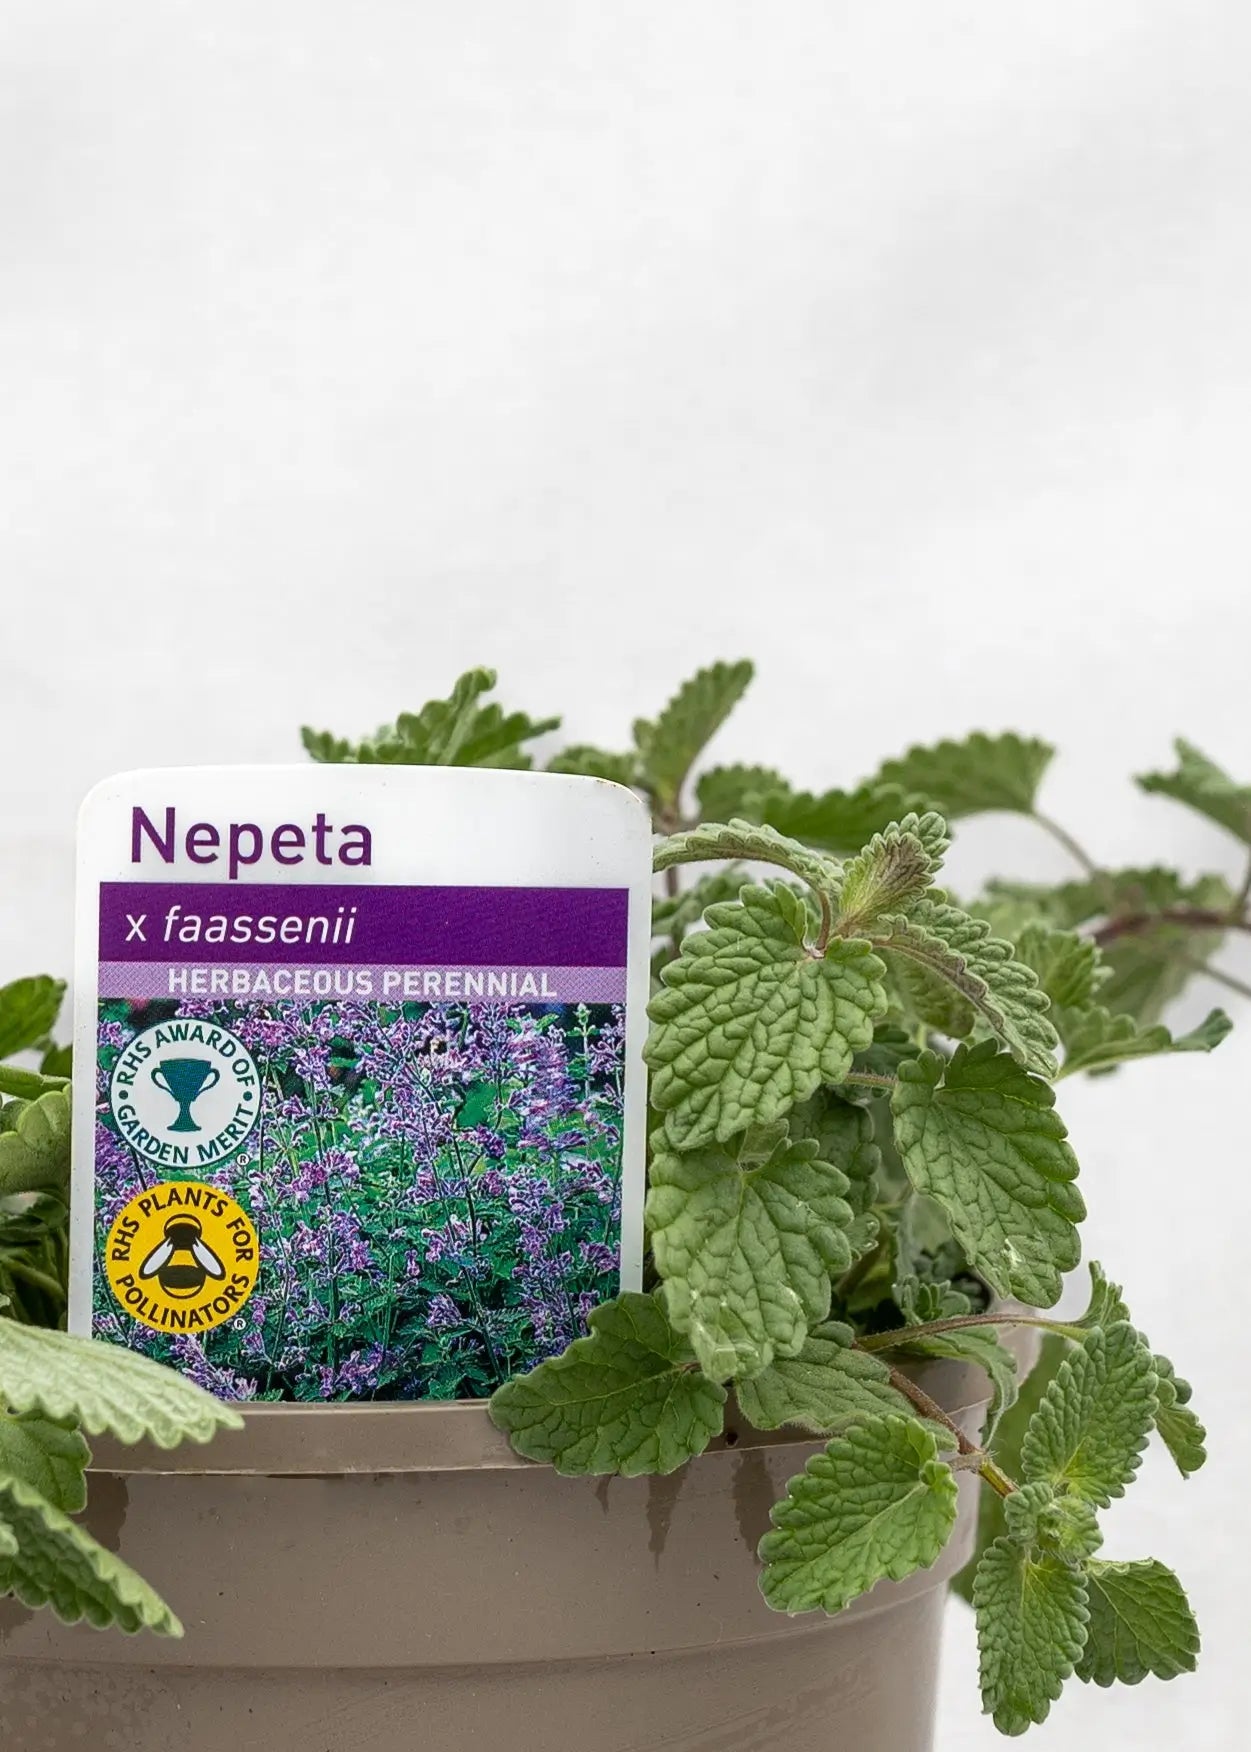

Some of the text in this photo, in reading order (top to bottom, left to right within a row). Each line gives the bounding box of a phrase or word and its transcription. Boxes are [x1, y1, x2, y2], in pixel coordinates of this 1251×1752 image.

[131, 806, 373, 880] Nepeta
[162, 906, 357, 944] faassenii
[167, 968, 558, 998] HERBACEOUS PERENNIAL
[117, 1023, 255, 1087] RHS AWARD OF
[117, 1103, 254, 1164] GARDEN MERIT
[112, 1187, 254, 1263] RHS PLANTS FOR
[115, 1273, 250, 1329] POLLINATORS
